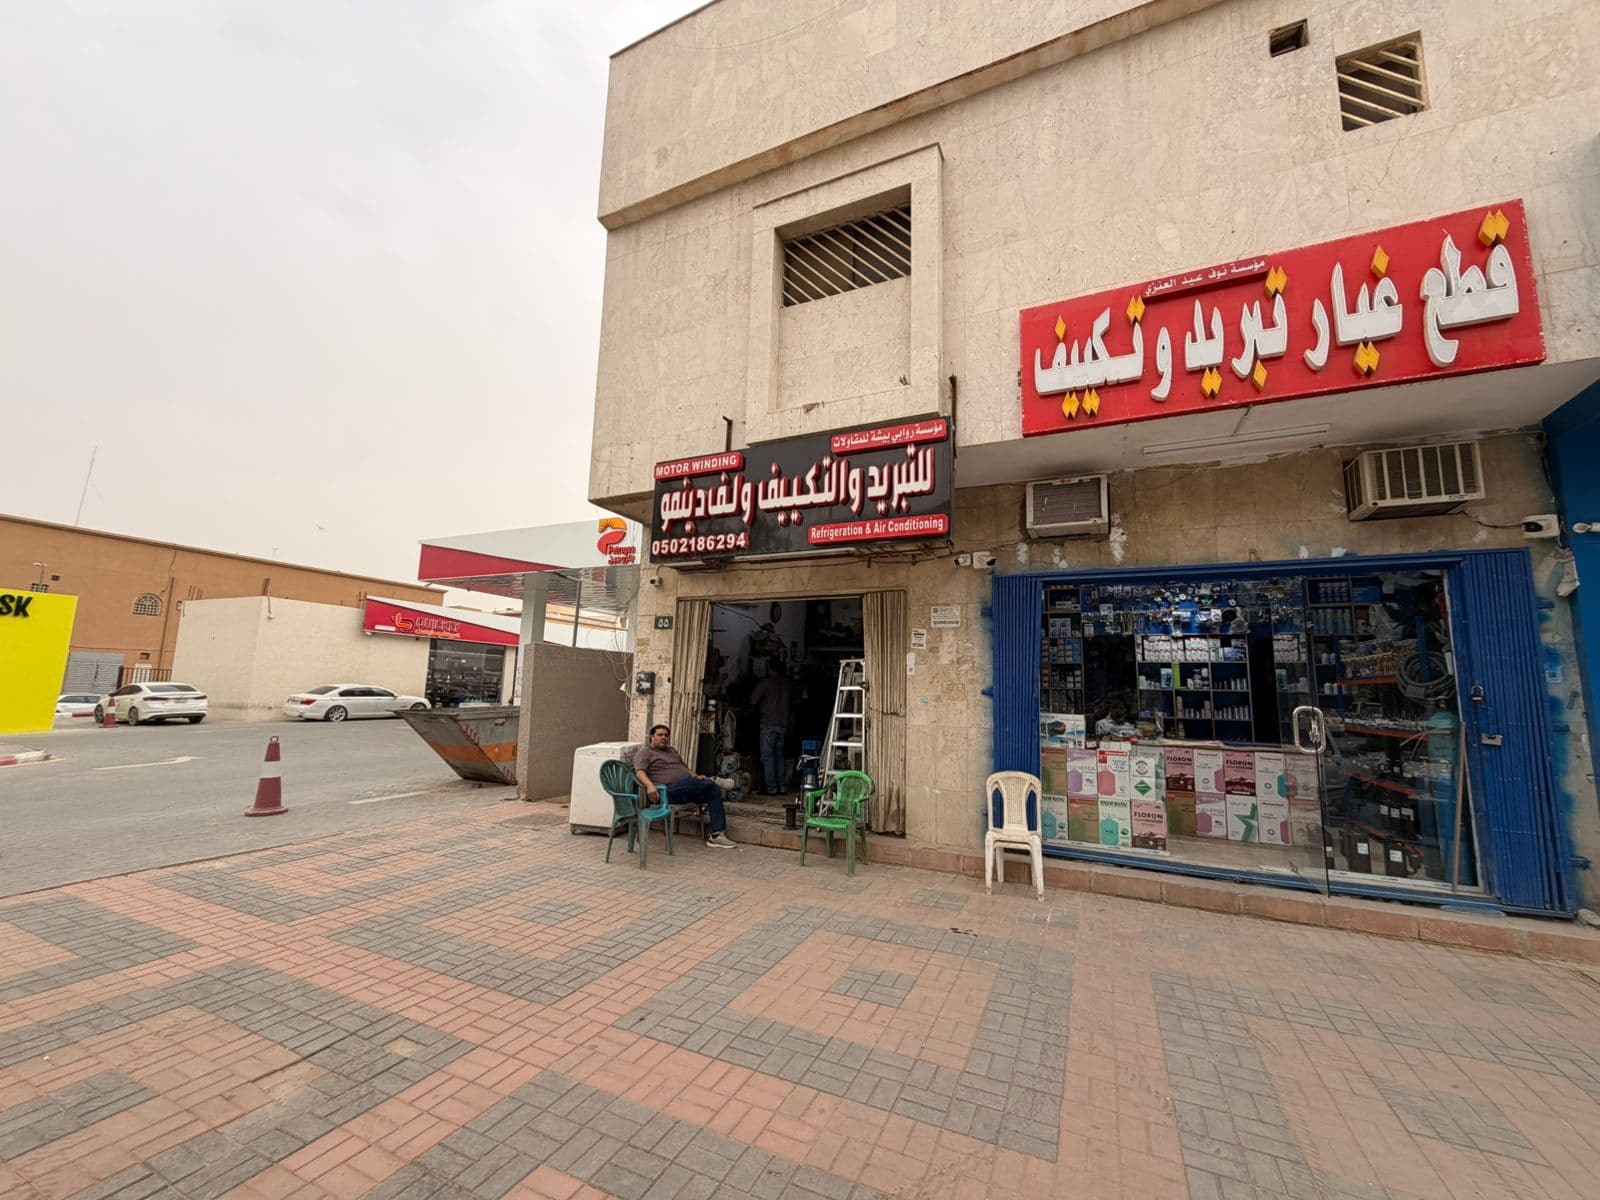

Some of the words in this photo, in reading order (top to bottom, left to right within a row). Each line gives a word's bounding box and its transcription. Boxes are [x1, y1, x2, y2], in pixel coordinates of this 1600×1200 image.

[1230, 259, 1266, 273] مؤسسة
[1145, 278, 1177, 297] العنزي
[1419, 208, 1520, 368] قطع
[1304, 245, 1403, 377] غيار
[1184, 265, 1289, 398] تبريد
[833, 432, 869, 449] للمقاولات
[915, 421, 943, 435] مؤسسة
[656, 462, 690, 477] MOTOR
[691, 455, 738, 472] WINDING
[867, 443, 935, 516] للتبريد
[660, 476, 706, 534] دينمو
[708, 472, 753, 524] ولف
[757, 454, 863, 526] والتكييف
[652, 532, 747, 555] 0502186294
[811, 525, 863, 541] Refrigeration
[865, 523, 872, 534] &
[873, 521, 887, 534] Air
[887, 517, 944, 532] Conditioning
